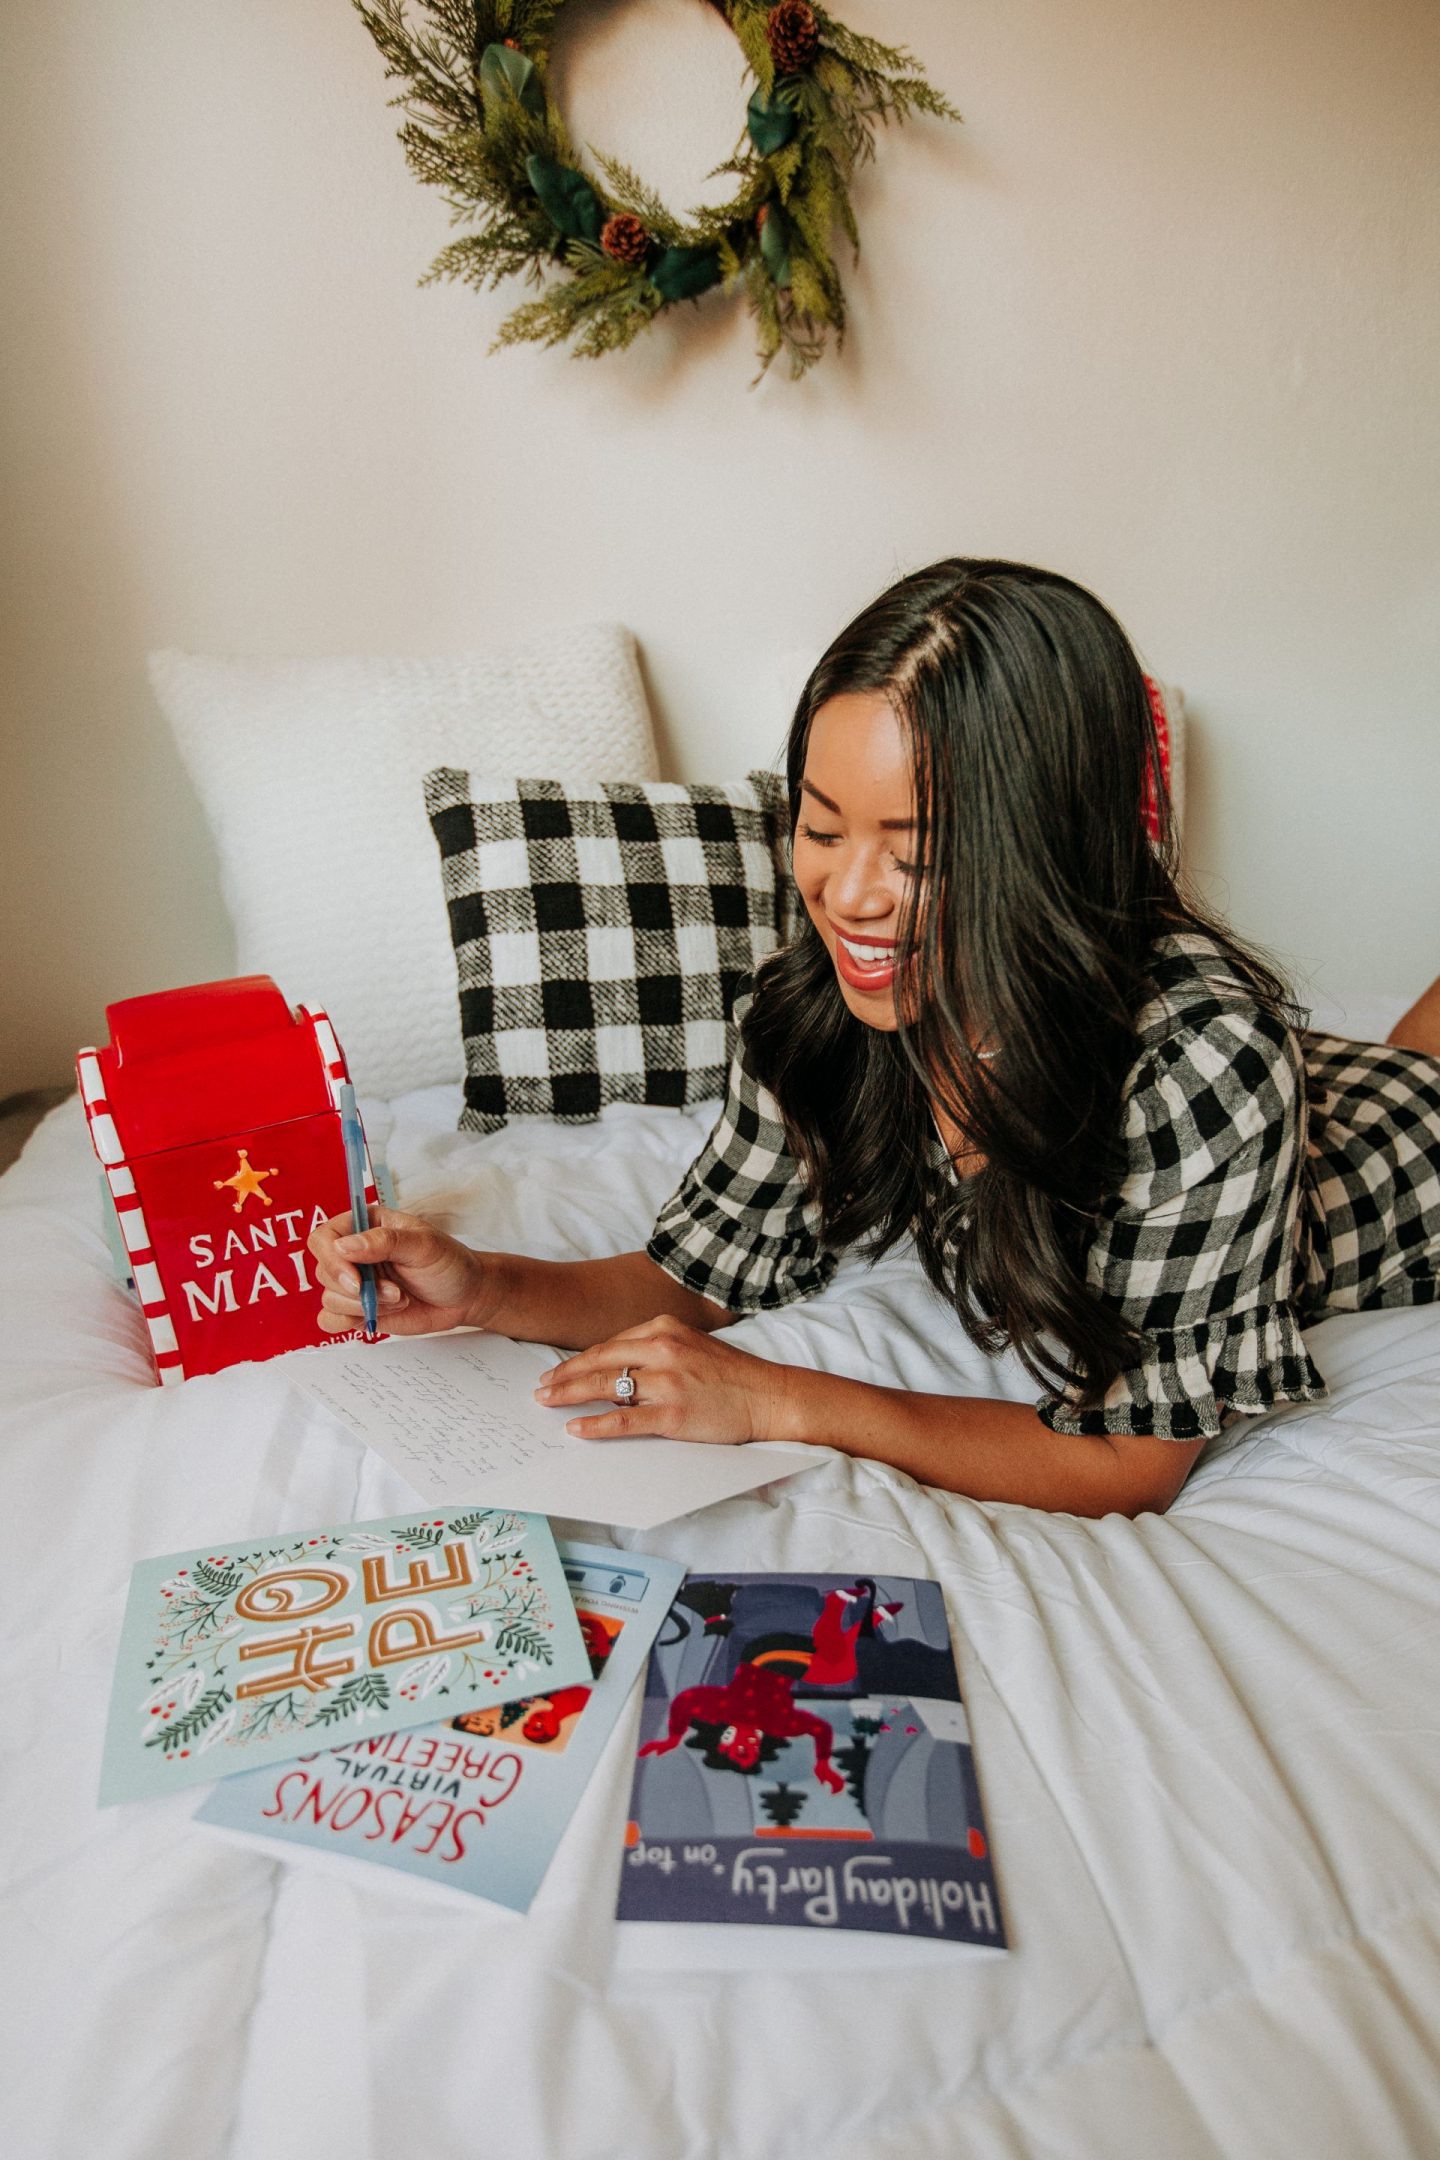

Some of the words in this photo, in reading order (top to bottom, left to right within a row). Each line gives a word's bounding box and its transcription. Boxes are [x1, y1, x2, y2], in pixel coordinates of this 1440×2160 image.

[188, 1205, 329, 1269] SANTA
[181, 1250, 314, 1323] MAI
[298, 1732, 523, 1808] GREETIN
[336, 1757, 461, 1799] VIRTUAL
[262, 1772, 486, 1862] SEASON'S
[628, 1841, 677, 1873] top
[731, 1847, 839, 1925] Party
[843, 1855, 997, 1934] Holiday
